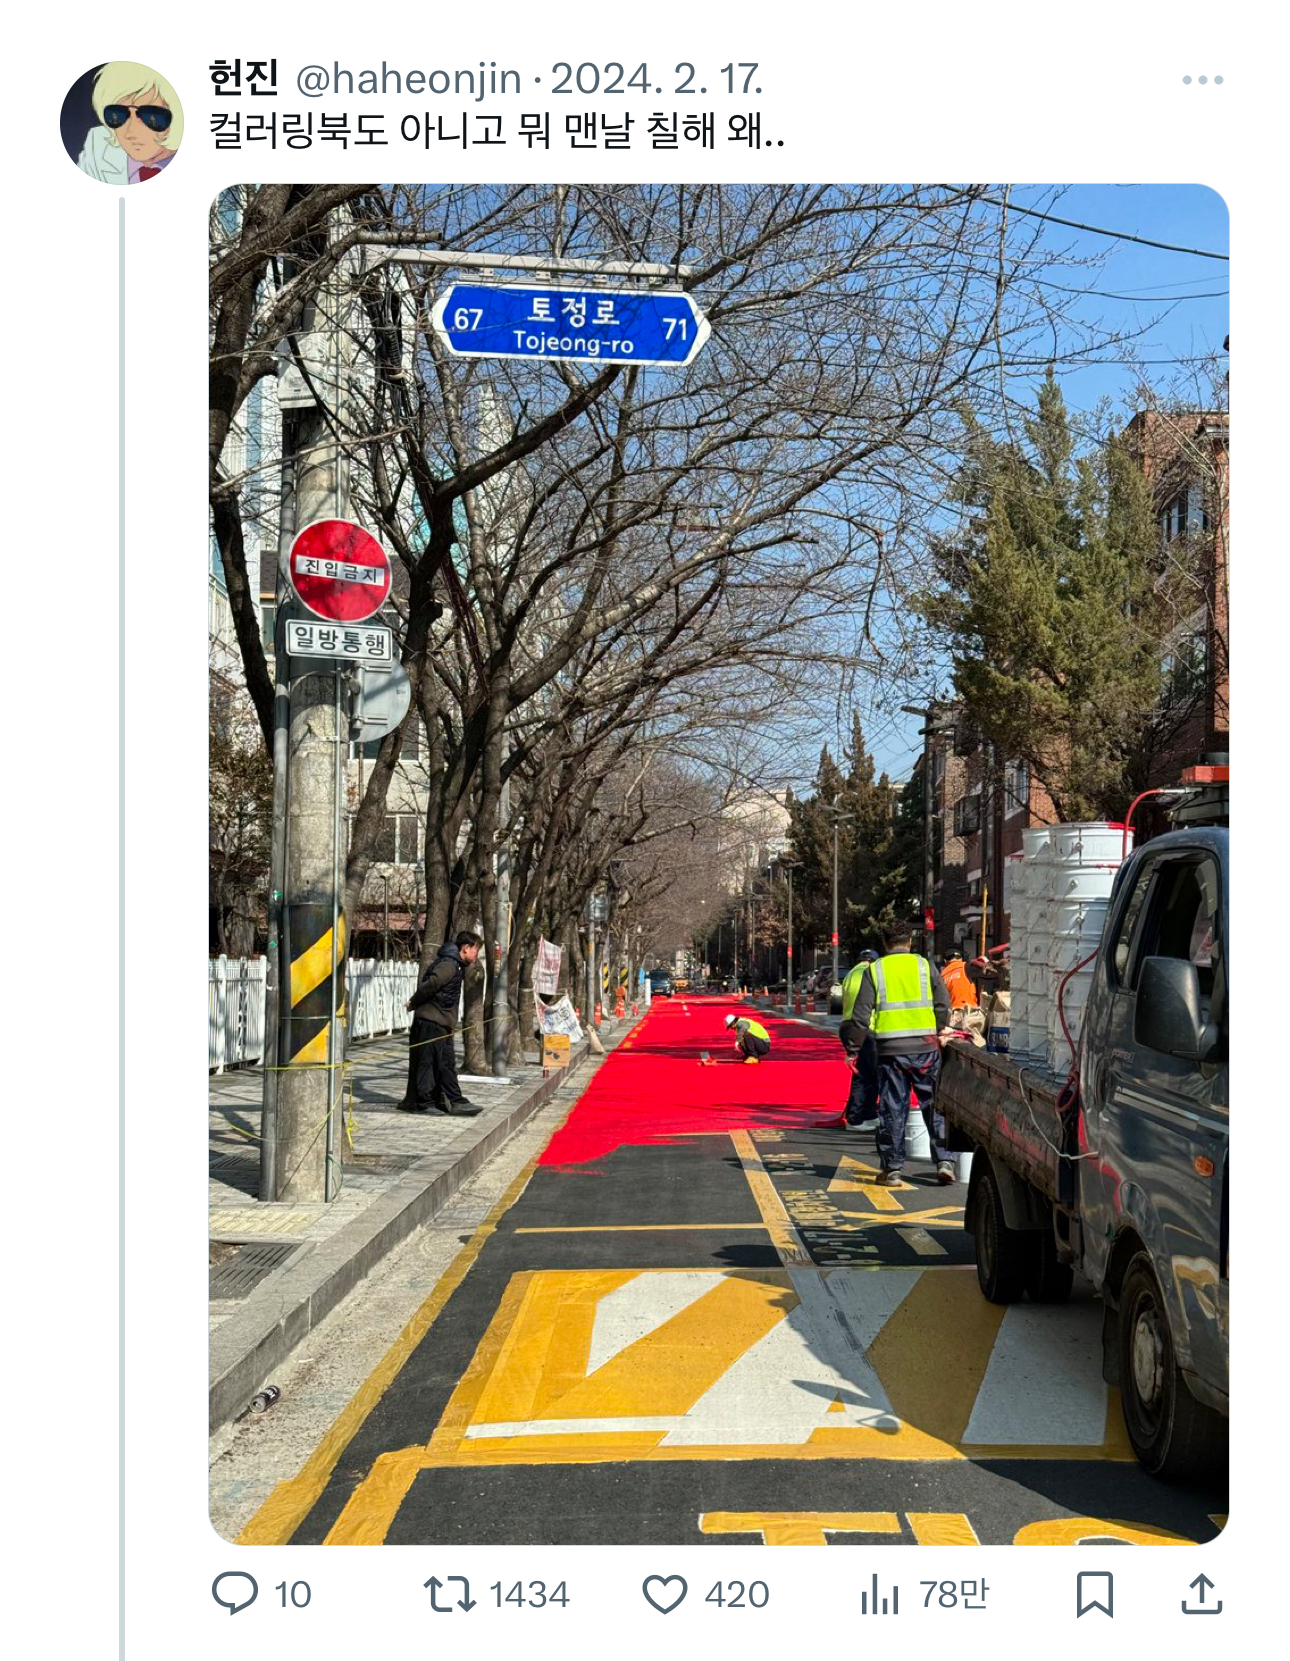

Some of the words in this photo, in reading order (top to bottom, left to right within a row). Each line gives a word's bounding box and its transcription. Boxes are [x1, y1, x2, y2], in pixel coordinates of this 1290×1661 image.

[454, 308, 483, 331] 67
[528, 297, 620, 328] 토정로
[662, 317, 688, 341] 71
[513, 330, 635, 355] Tojeong-ro
[305, 559, 377, 584] 진입금지
[295, 626, 385, 657] 일방통행
